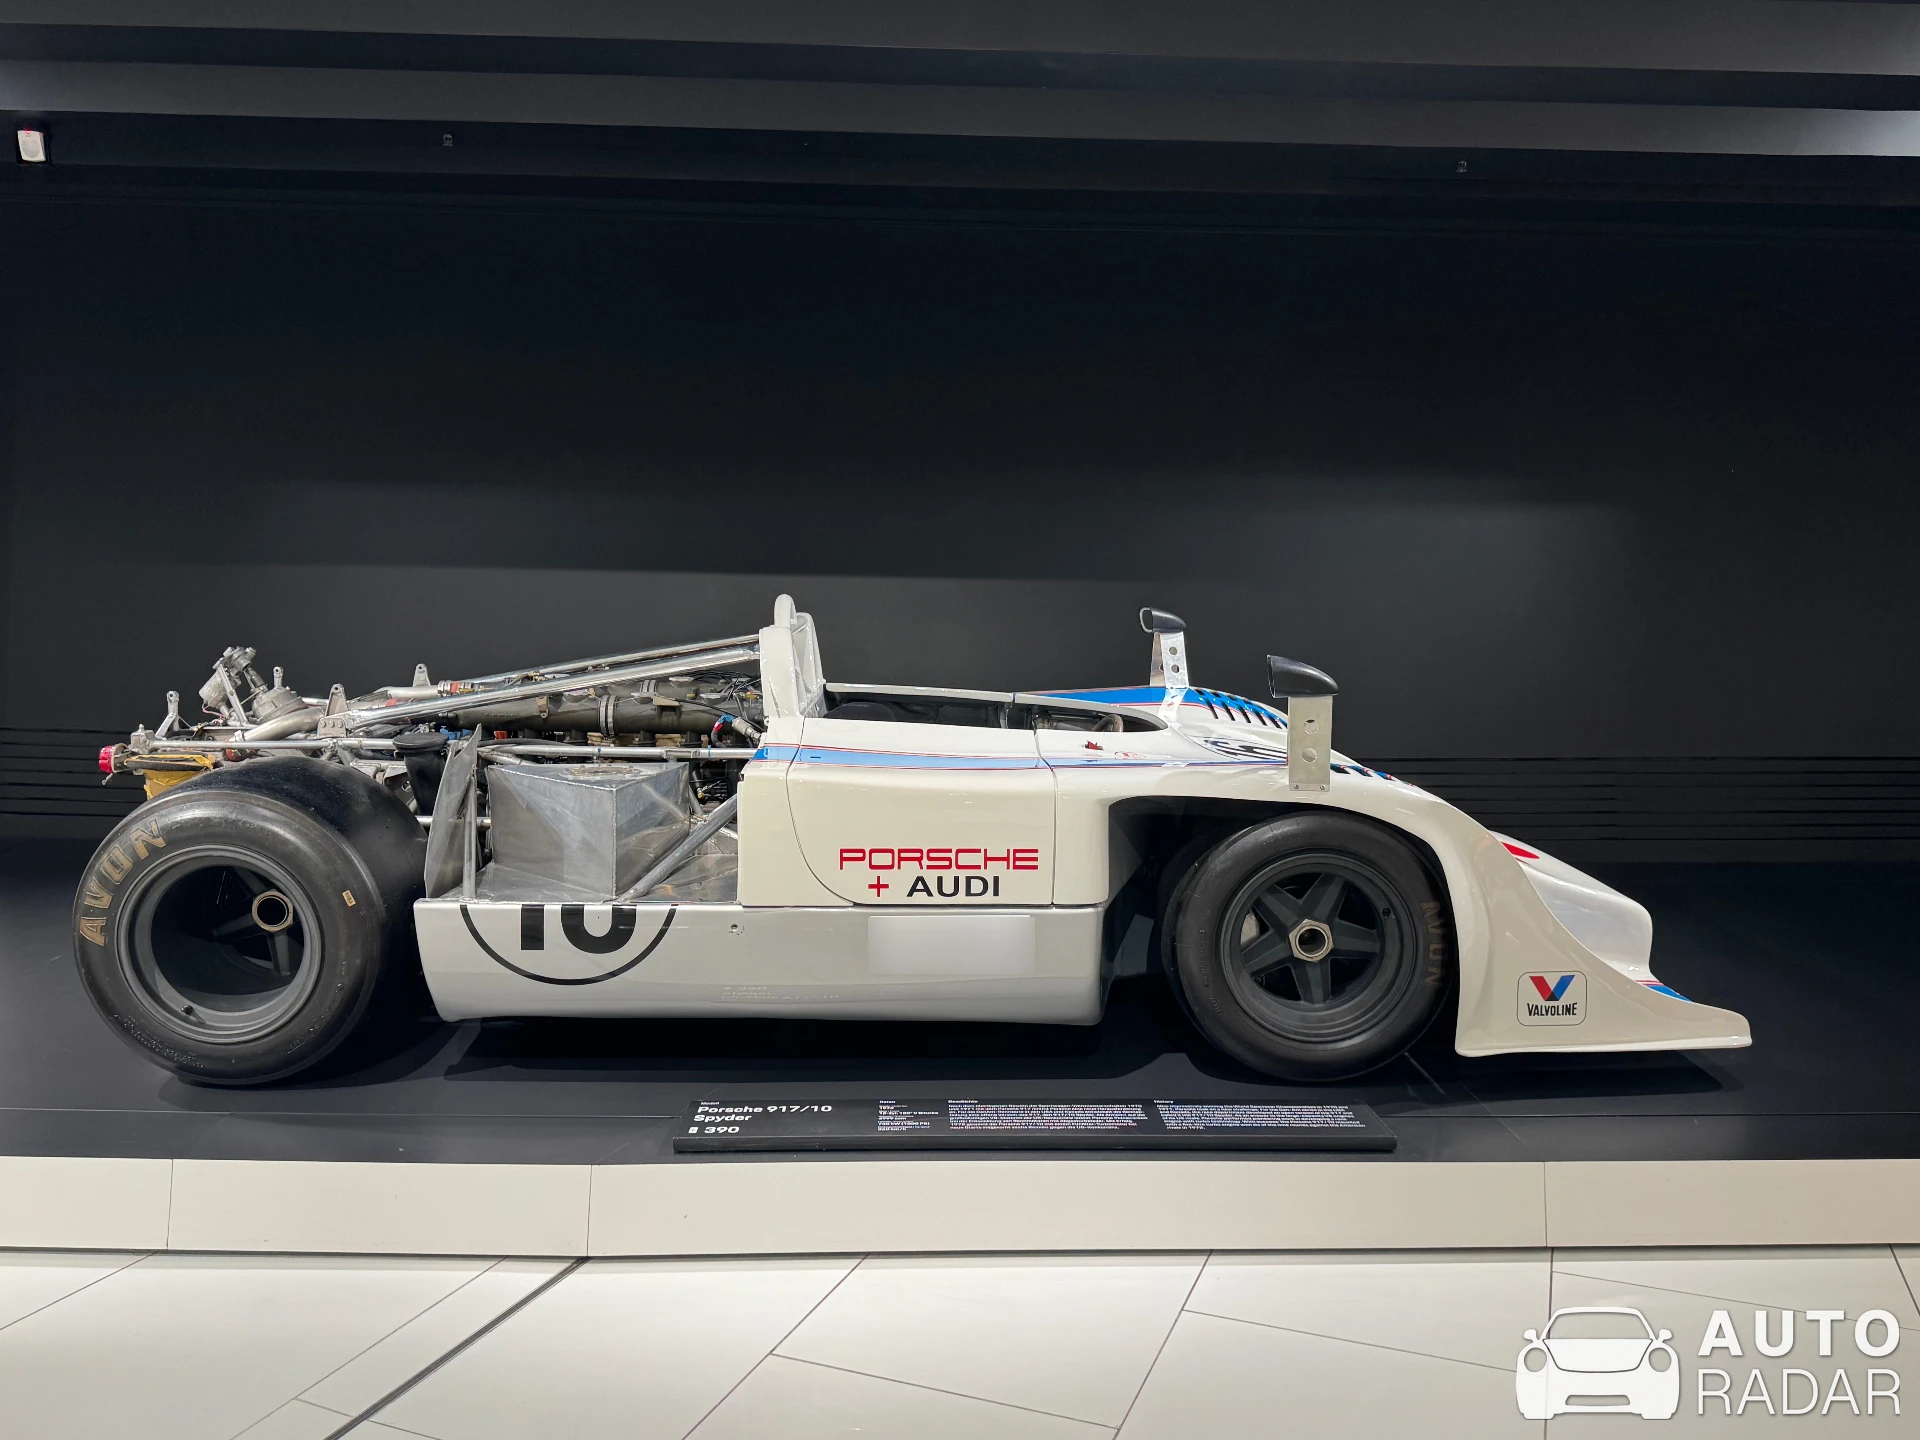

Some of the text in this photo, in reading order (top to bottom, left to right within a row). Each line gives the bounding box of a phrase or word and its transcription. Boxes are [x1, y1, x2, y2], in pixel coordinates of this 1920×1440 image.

[839, 848, 1039, 870] PORSCHE
[80, 819, 166, 946] AVON
[906, 876, 999, 897] AUDI
[1527, 1002, 1577, 1016] VALVOLINE
[766, 1105, 832, 1113] 917/10
[693, 1114, 752, 1123] Spyder
[704, 1126, 740, 1134] 390
